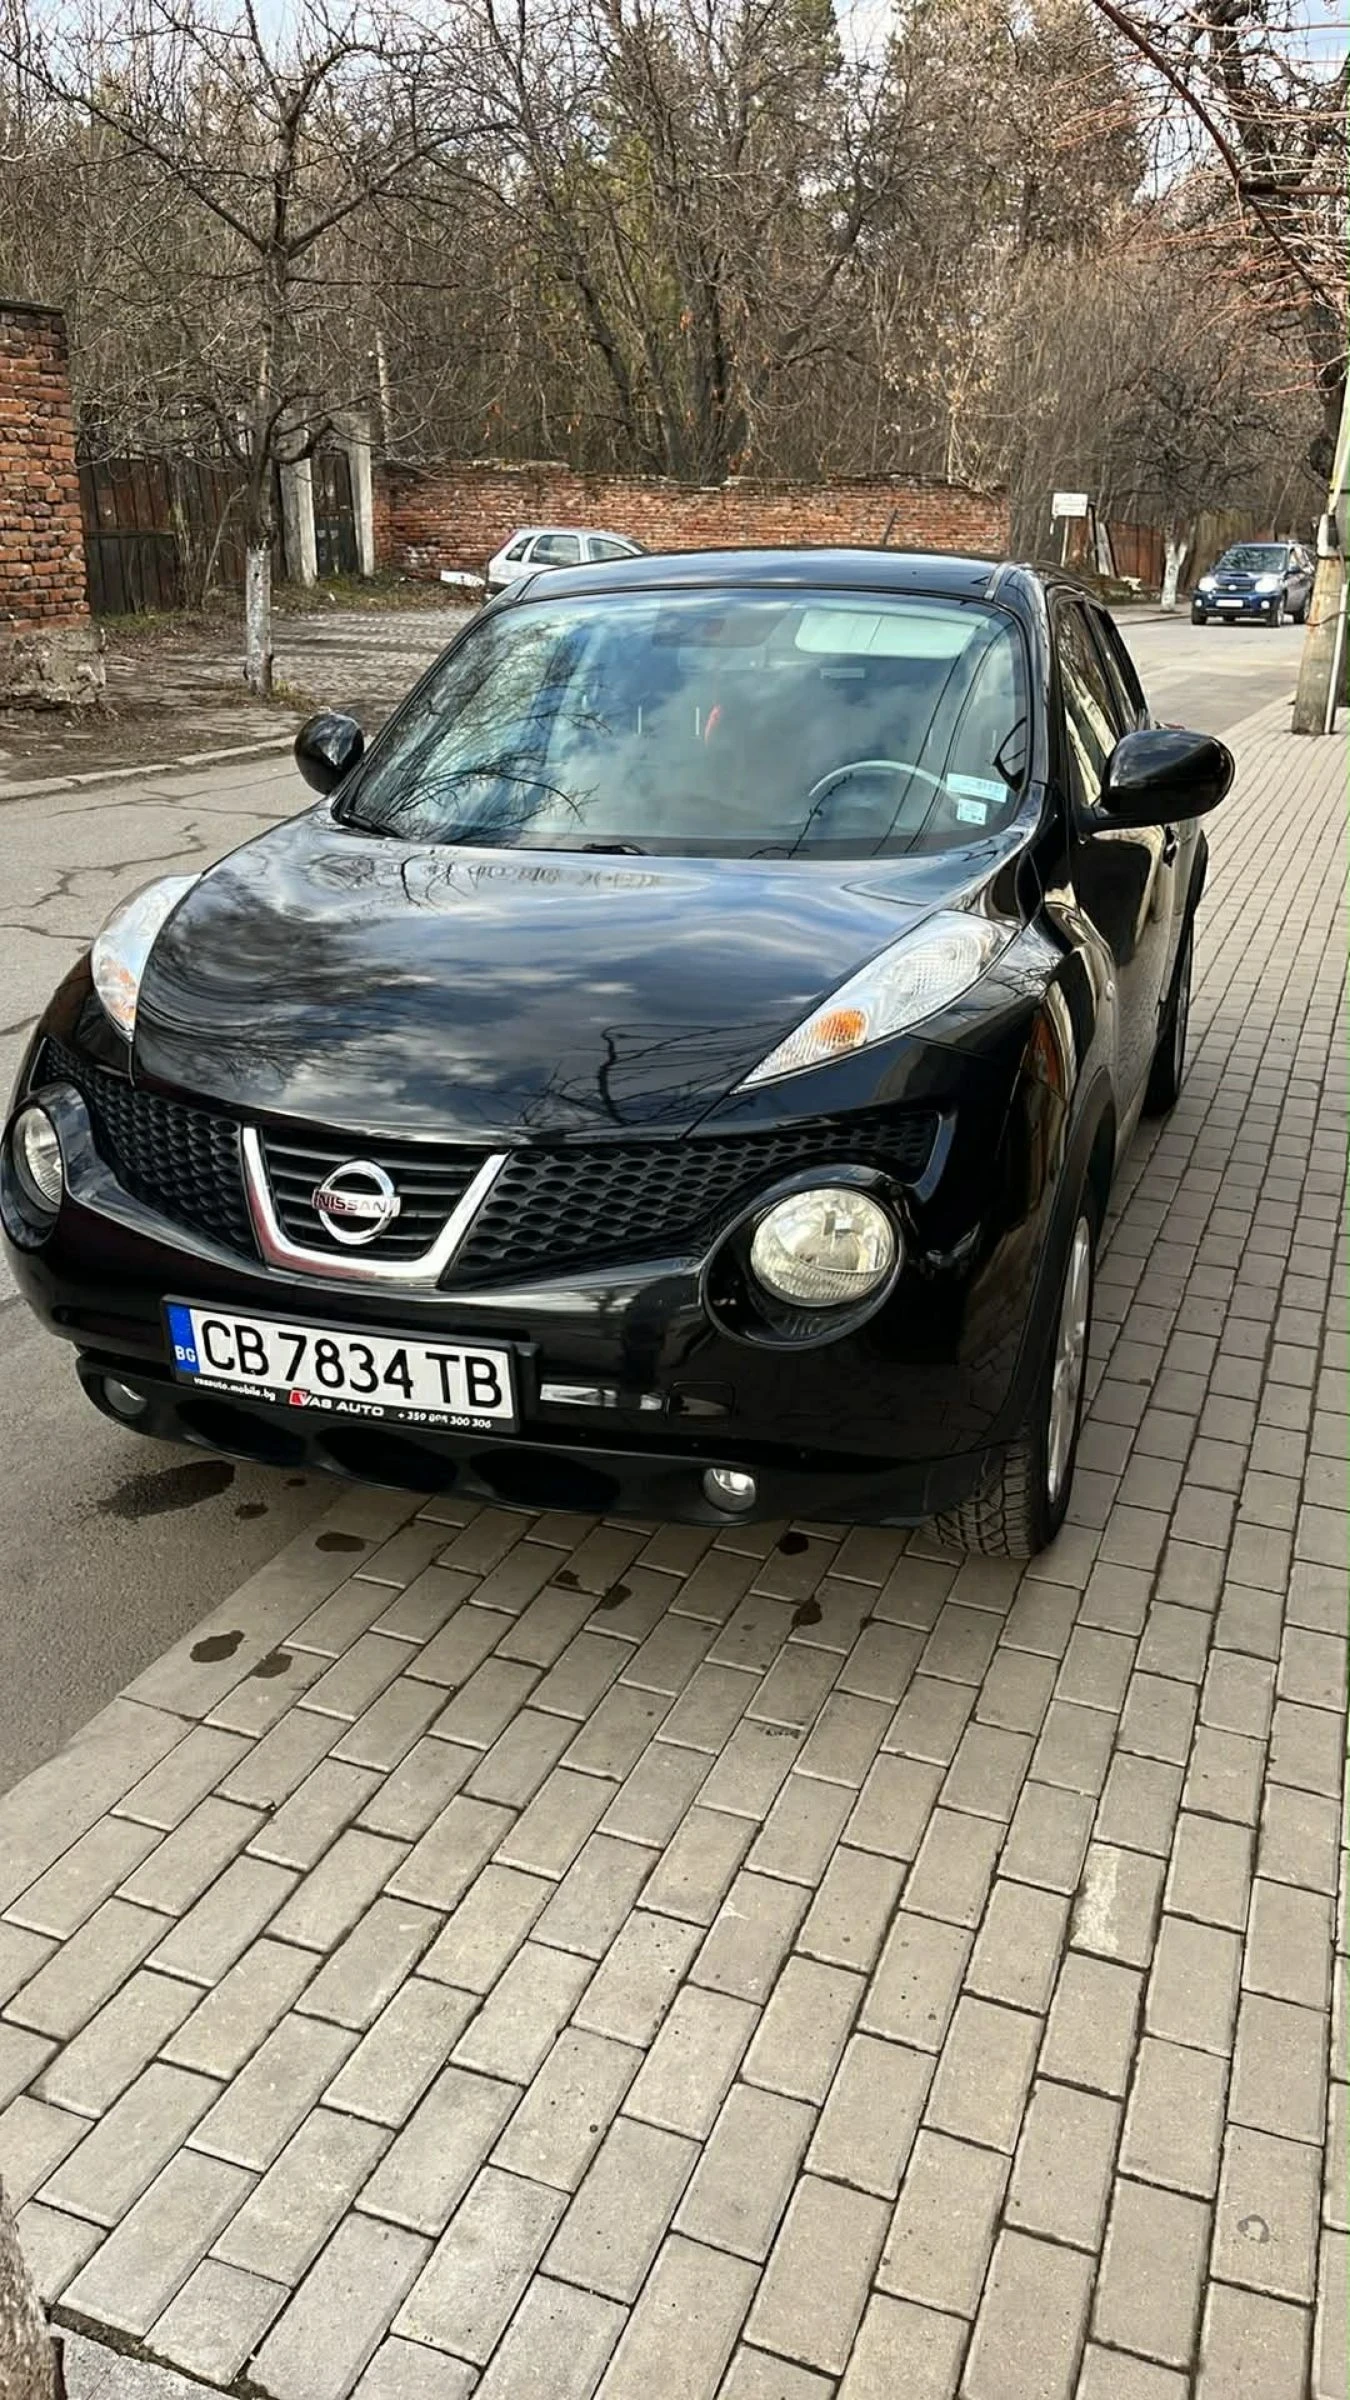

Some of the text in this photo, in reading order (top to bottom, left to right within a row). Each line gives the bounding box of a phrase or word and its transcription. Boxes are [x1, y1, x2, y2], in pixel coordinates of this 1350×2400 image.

[318, 1193, 386, 1213] NISSAN
[174, 1344, 197, 1363] BG
[201, 1319, 503, 1409] CB 7834 TB
[336, 1400, 384, 1417] AUTO
